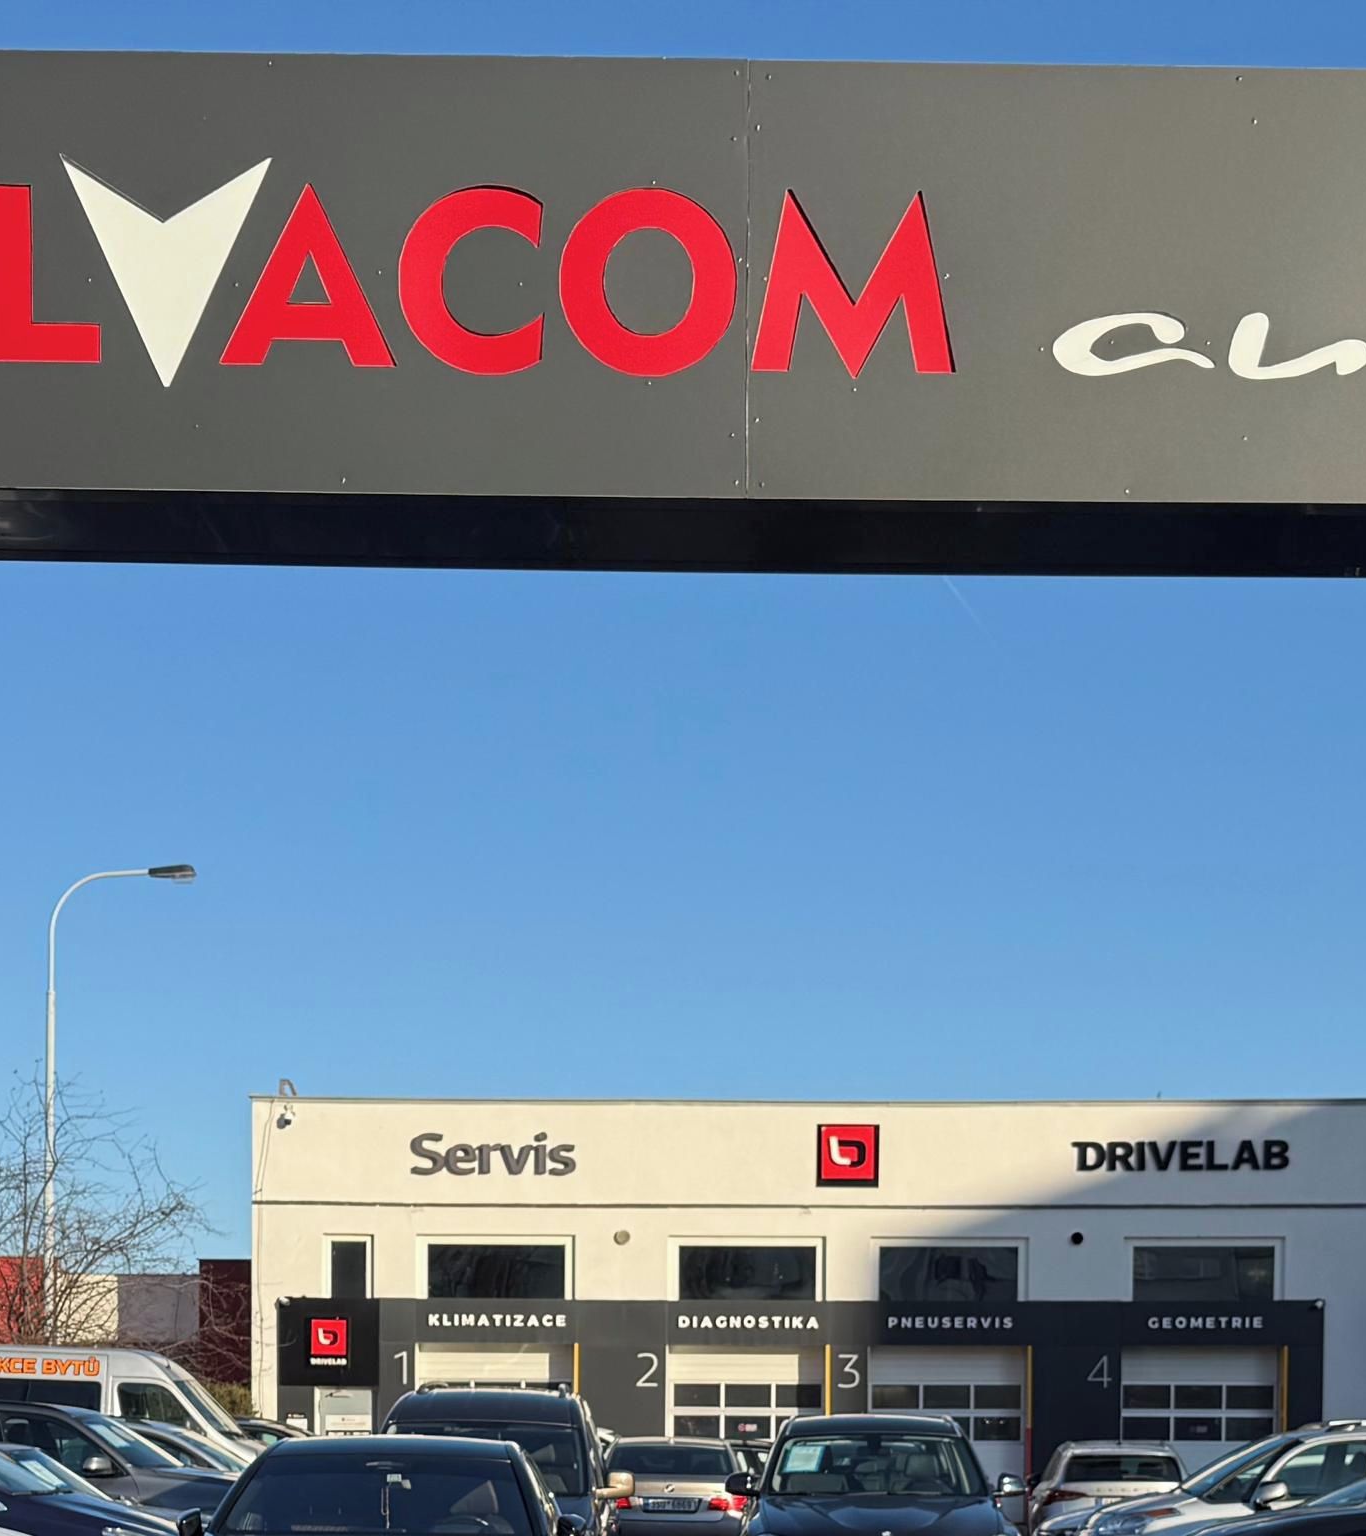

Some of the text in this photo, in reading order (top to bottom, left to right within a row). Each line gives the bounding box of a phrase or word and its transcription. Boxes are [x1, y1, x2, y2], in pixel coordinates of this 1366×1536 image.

[409, 1131, 577, 1177] Servis
[1071, 1140, 1290, 1172] DRIVELAB
[428, 1313, 567, 1328] KLIMATIZACE
[678, 1314, 819, 1330] DIAGNOSTIKA
[887, 1316, 1013, 1330] PNEUSERVIS
[1147, 1316, 1264, 1330] GEOMETRIE
[41, 1355, 100, 1377] BYTŮ
[393, 1350, 408, 1386] 1
[635, 1352, 659, 1388] 2
[837, 1353, 861, 1389] 3
[1086, 1355, 1113, 1389] 4
